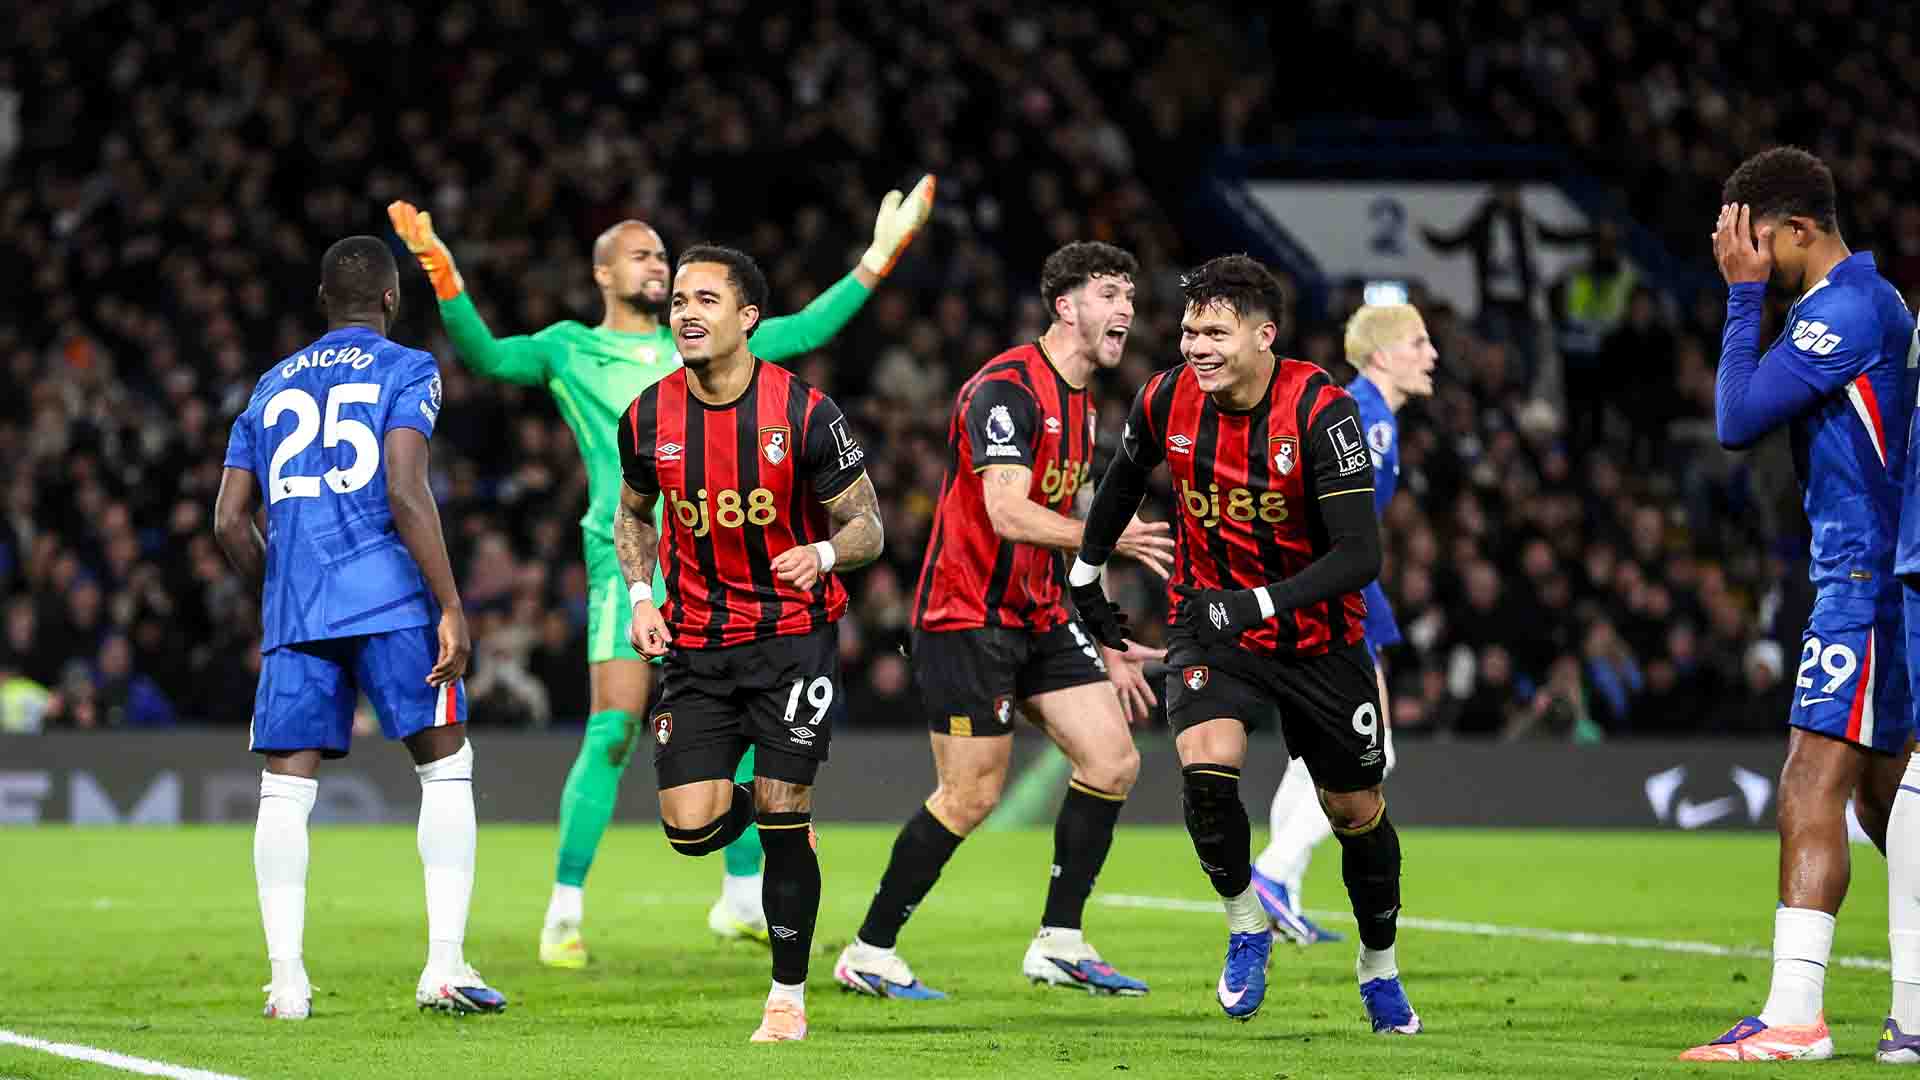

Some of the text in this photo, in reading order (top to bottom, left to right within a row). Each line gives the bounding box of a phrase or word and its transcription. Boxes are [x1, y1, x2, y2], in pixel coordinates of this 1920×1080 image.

[1366, 194, 1406, 256] 2
[281, 346, 374, 379] CAICEDO
[263, 382, 382, 505] 25
[670, 488, 777, 538] bj88
[1181, 480, 1289, 528] bj88
[1796, 636, 1857, 694] 29
[783, 676, 833, 725] 19
[789, 735, 813, 747] umbro
[1351, 701, 1378, 750] 9
